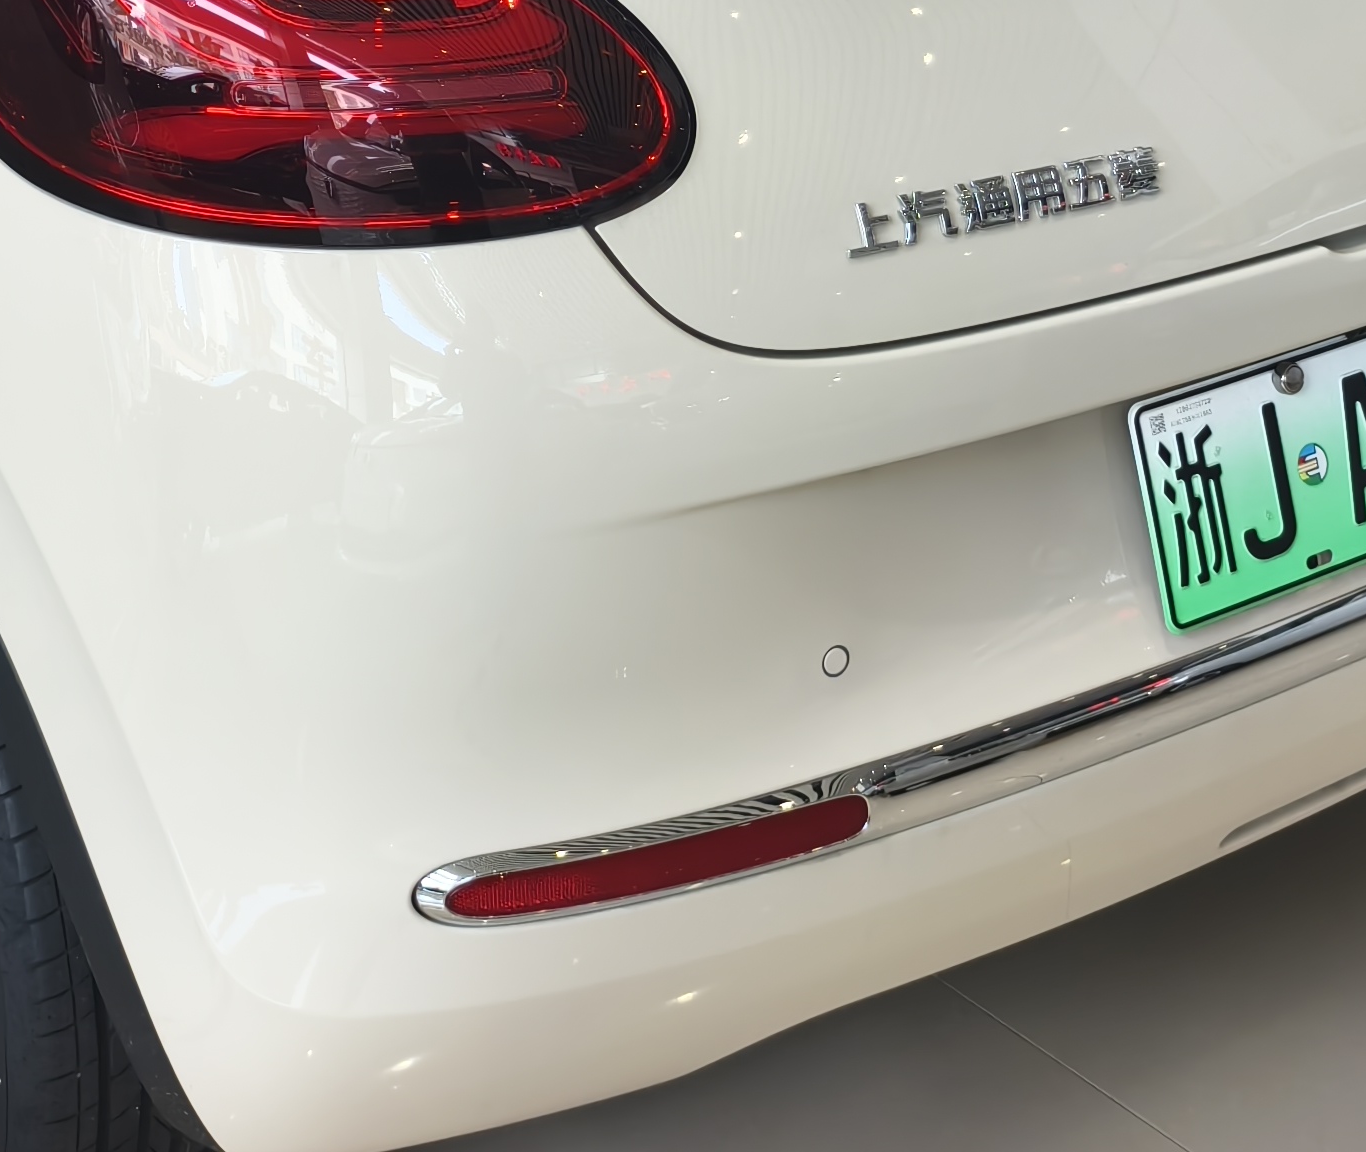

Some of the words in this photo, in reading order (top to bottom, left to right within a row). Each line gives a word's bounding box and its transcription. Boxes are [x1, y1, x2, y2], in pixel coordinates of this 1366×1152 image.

[846, 146, 1161, 260] 上汽通用五菱
